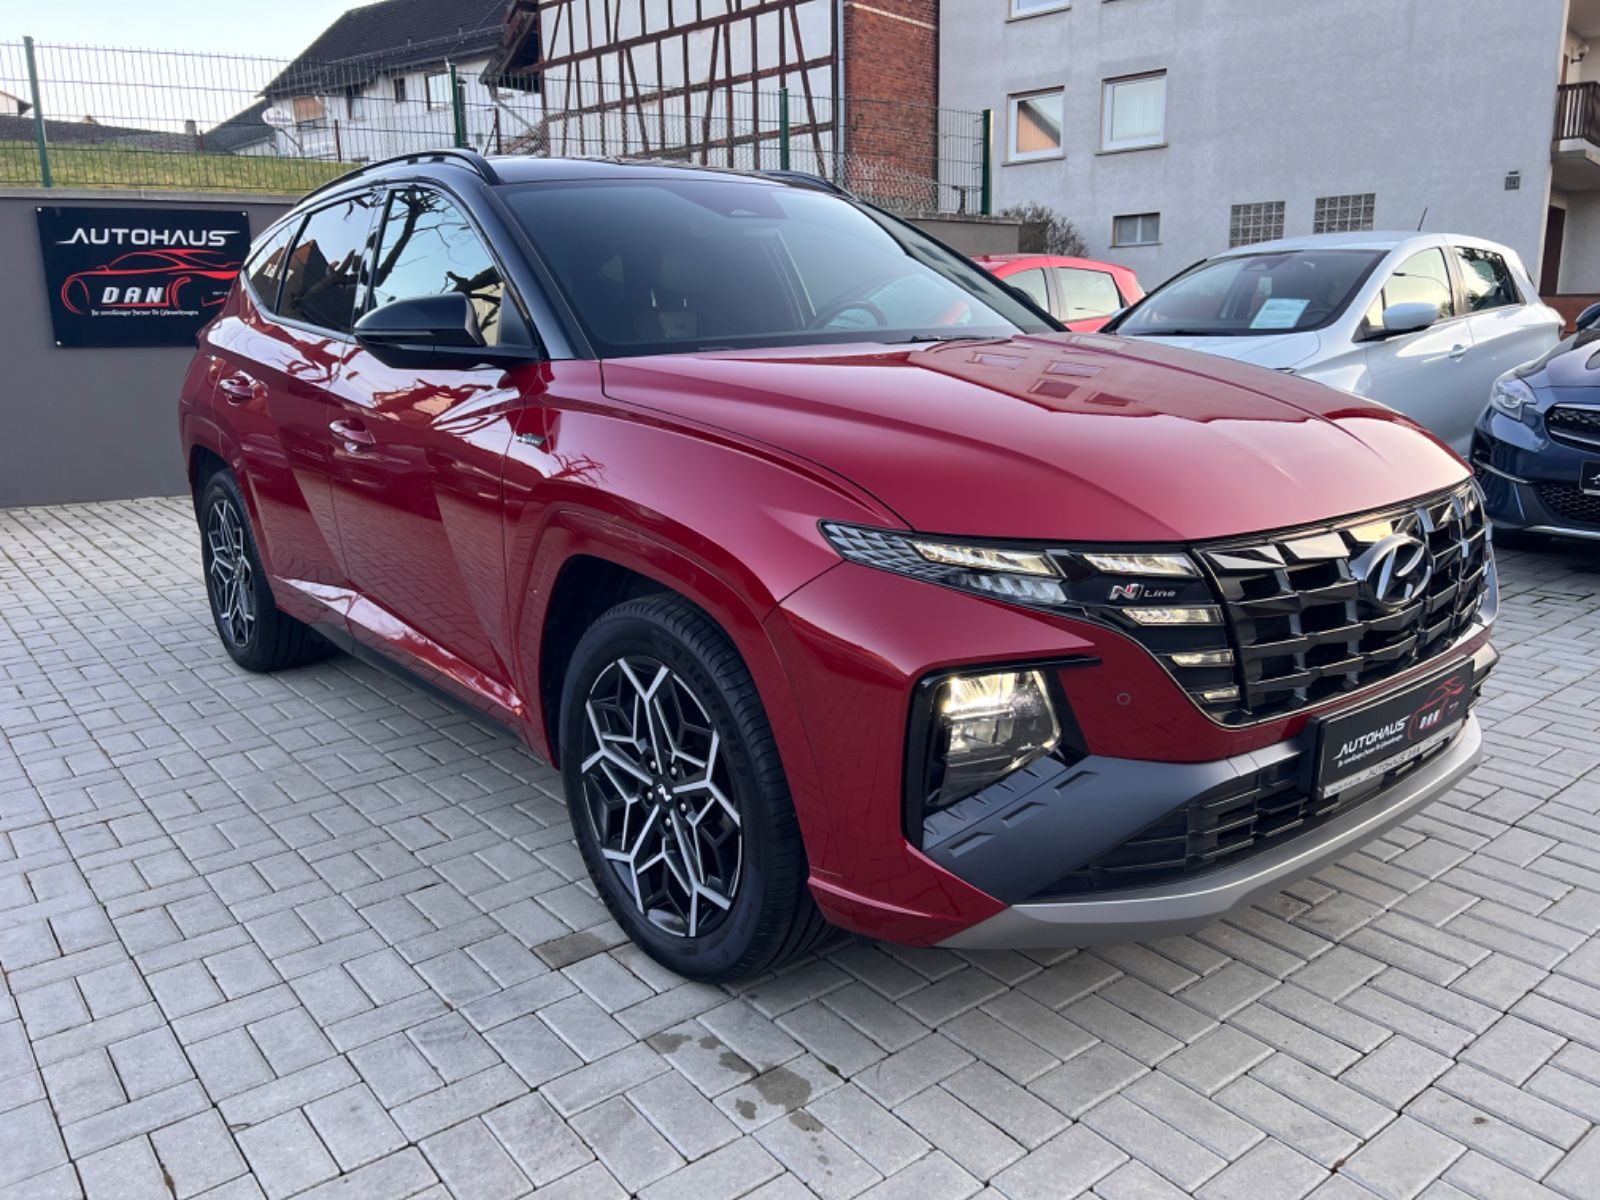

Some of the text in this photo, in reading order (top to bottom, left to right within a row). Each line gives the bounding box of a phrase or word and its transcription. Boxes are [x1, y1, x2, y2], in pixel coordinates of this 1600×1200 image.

[56, 228, 240, 246] AUTOHAUS
[101, 286, 164, 304] DAN
[1332, 714, 1411, 761] AUTOHAUS
